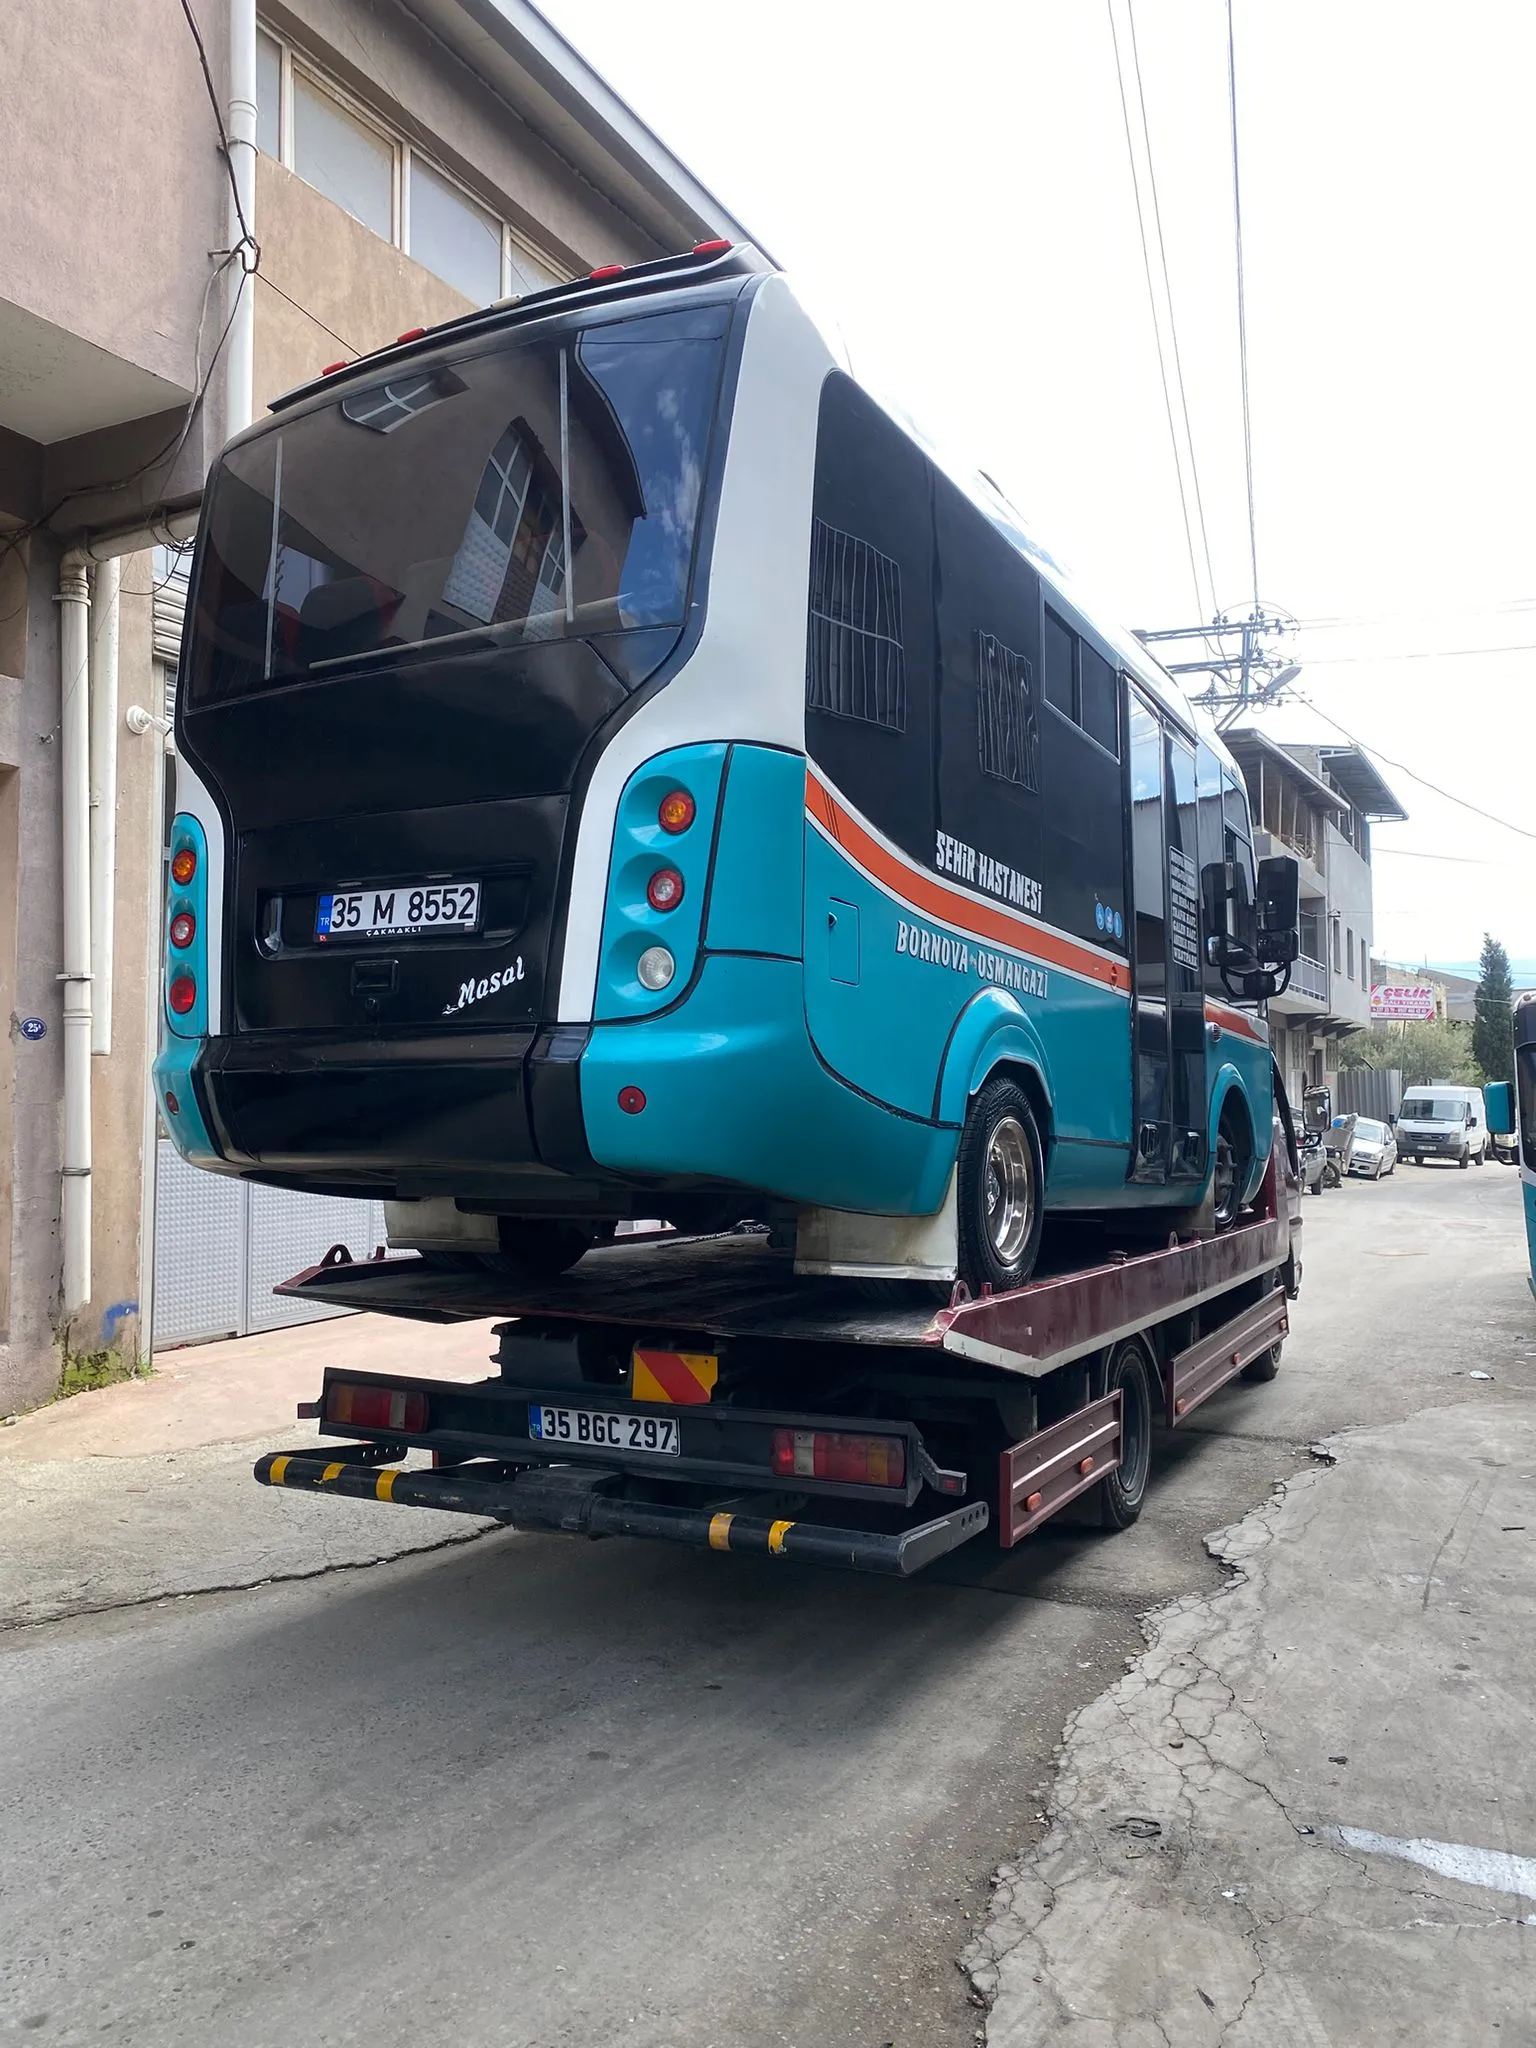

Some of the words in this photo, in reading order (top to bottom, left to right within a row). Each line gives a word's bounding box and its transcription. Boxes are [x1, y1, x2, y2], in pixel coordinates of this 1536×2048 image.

[978, 852, 1042, 914] HASTANESİ
[320, 917, 329, 926] TR
[331, 896, 362, 928] 35
[372, 893, 395, 925] M
[408, 887, 475, 922] 8552
[366, 926, 421, 937] ÇAKMAKLI
[896, 920, 968, 973] BORNOVA
[977, 949, 1048, 999] OSMANGAZİ
[458, 955, 525, 1008] Masal
[1383, 987, 1432, 999] ÇELİK
[544, 1409, 570, 1438] 35
[577, 1413, 620, 1444] BGC
[628, 1418, 673, 1450] 297
